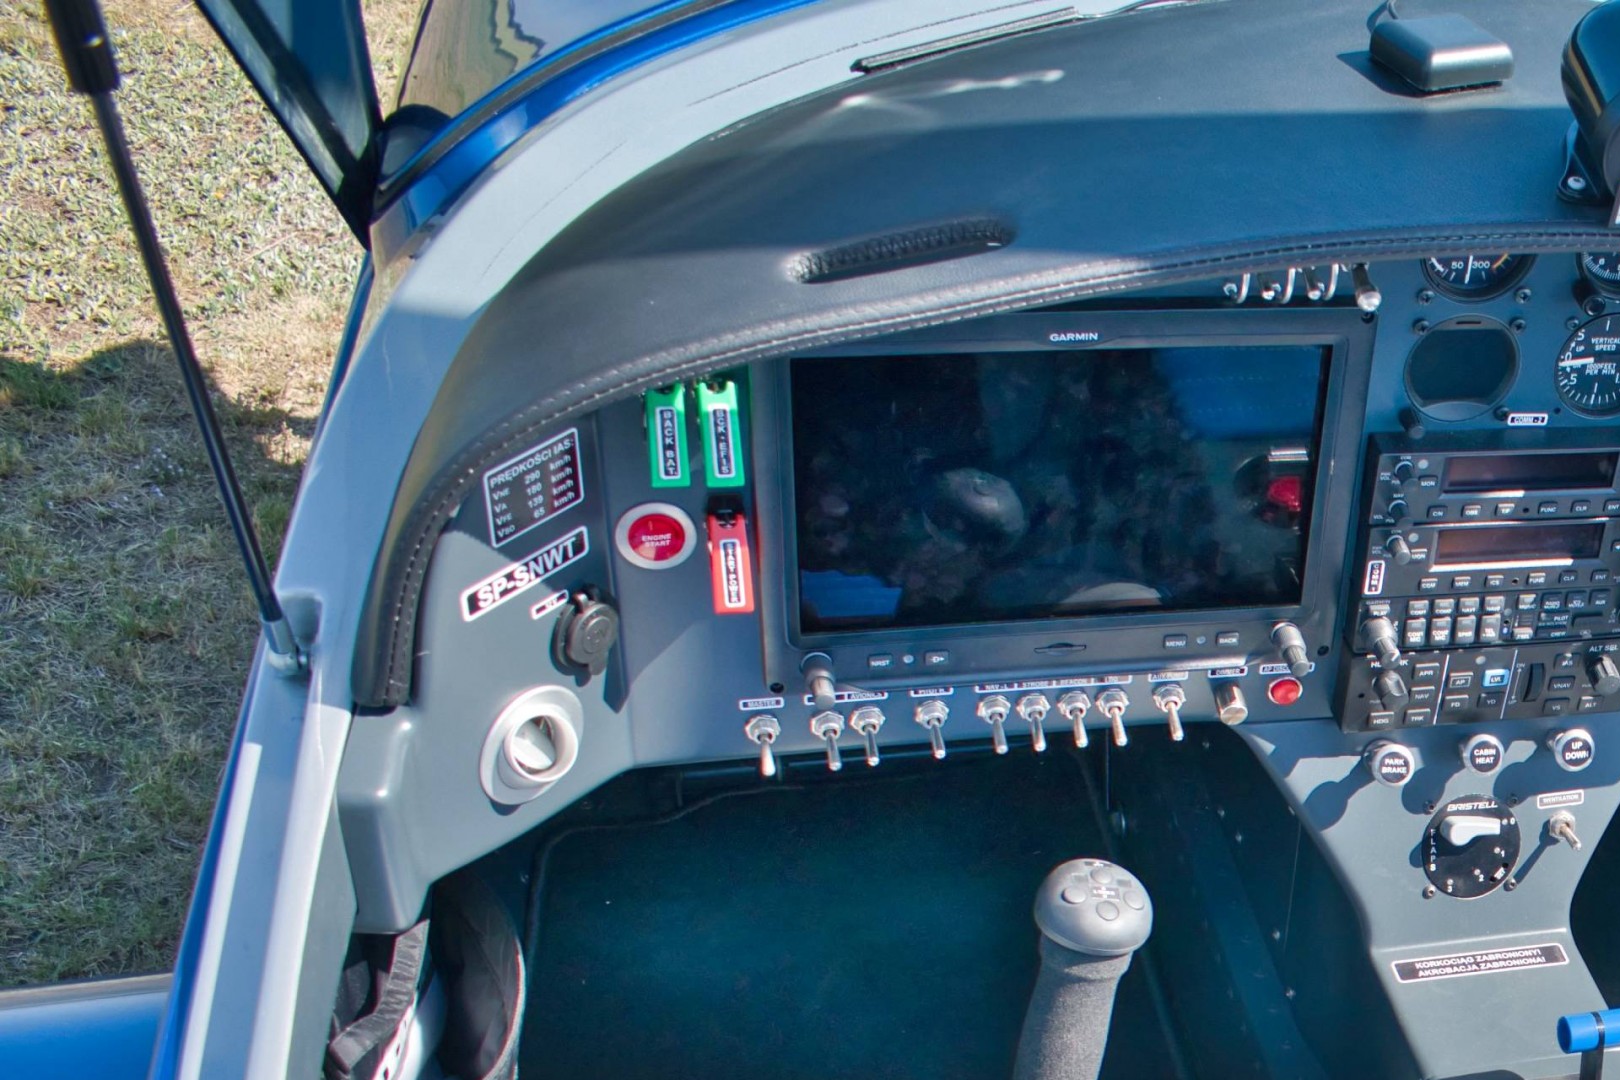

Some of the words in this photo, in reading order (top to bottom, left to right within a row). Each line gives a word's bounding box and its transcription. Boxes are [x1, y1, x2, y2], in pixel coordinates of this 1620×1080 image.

[1451, 261, 1464, 269] 50
[1472, 261, 1491, 269] 300
[1050, 332, 1098, 342] GARMIN
[1591, 337, 1620, 345] VERTICAL
[663, 410, 675, 445] BACK
[489, 449, 551, 488] PRĘDKOŚCI
[553, 438, 576, 457] IAS:
[549, 454, 572, 470] km/h
[551, 467, 573, 483] km/h
[552, 479, 574, 495] km/h
[554, 491, 576, 508] km/h
[641, 533, 671, 541] ENGINE
[476, 536, 577, 608] SP-SNWT
[871, 660, 890, 668] NRST
[1023, 680, 1049, 688] STROBE
[1060, 678, 1088, 686] BEACON
[748, 698, 777, 708] MASTER
[1571, 742, 1583, 750] UP
[1473, 749, 1496, 757] CABIN
[1565, 750, 1589, 759] DOWN
[1384, 758, 1404, 766] PARK
[1476, 757, 1495, 765] HEAT
[1381, 766, 1407, 774] BRAKE
[1447, 801, 1498, 811] BRISTELL
[1510, 817, 1515, 825] 0
[1479, 874, 1485, 882] 2
[1447, 885, 1453, 893] 3
[1414, 956, 1475, 970] KORKOCIĄG
[1474, 948, 1542, 962] ZABRONIONY!
[1417, 963, 1479, 977] AKROBACJA
[1478, 955, 1546, 970] ZABRONIONA!
